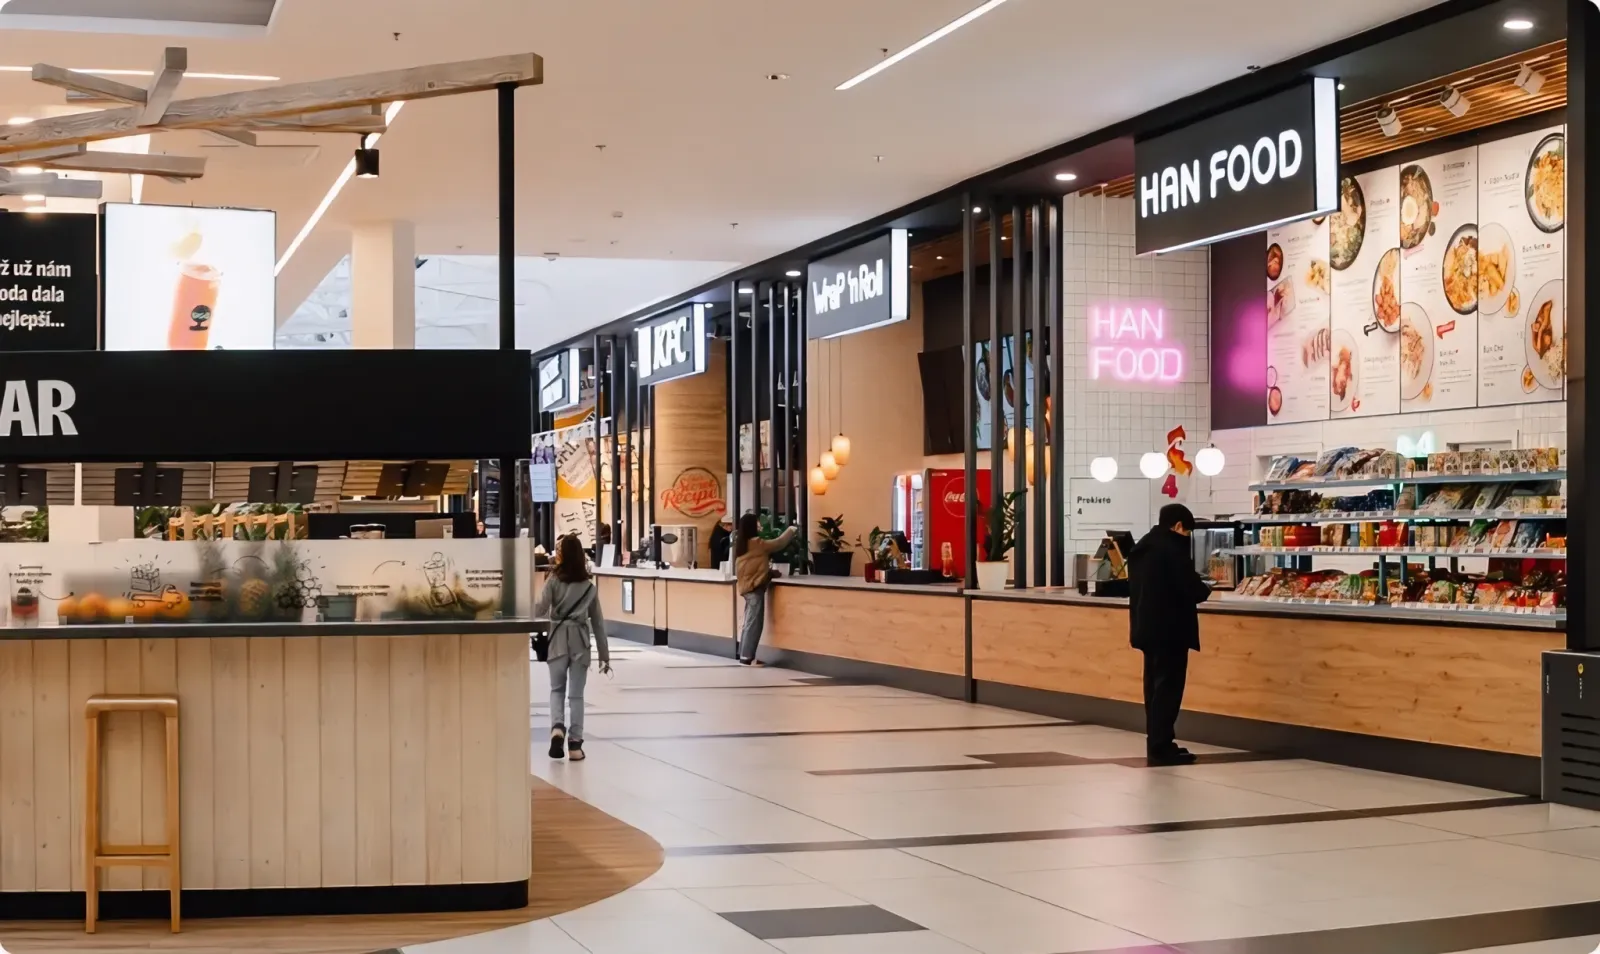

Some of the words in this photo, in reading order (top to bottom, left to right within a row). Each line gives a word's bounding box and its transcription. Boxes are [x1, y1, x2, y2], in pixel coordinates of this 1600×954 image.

[1141, 159, 1200, 218] HAN
[1210, 129, 1302, 199] FOOD
[0, 259, 10, 276] ž
[13, 259, 33, 276] už
[36, 260, 72, 277] nám
[859, 258, 883, 301] Roll
[0, 284, 28, 301] oda
[32, 285, 65, 302] dala
[0, 309, 66, 331] ejlepší...
[1093, 306, 1163, 340] HAN
[653, 316, 687, 371] KFC
[1092, 346, 1183, 381] FOOD
[0, 379, 79, 436] AR
